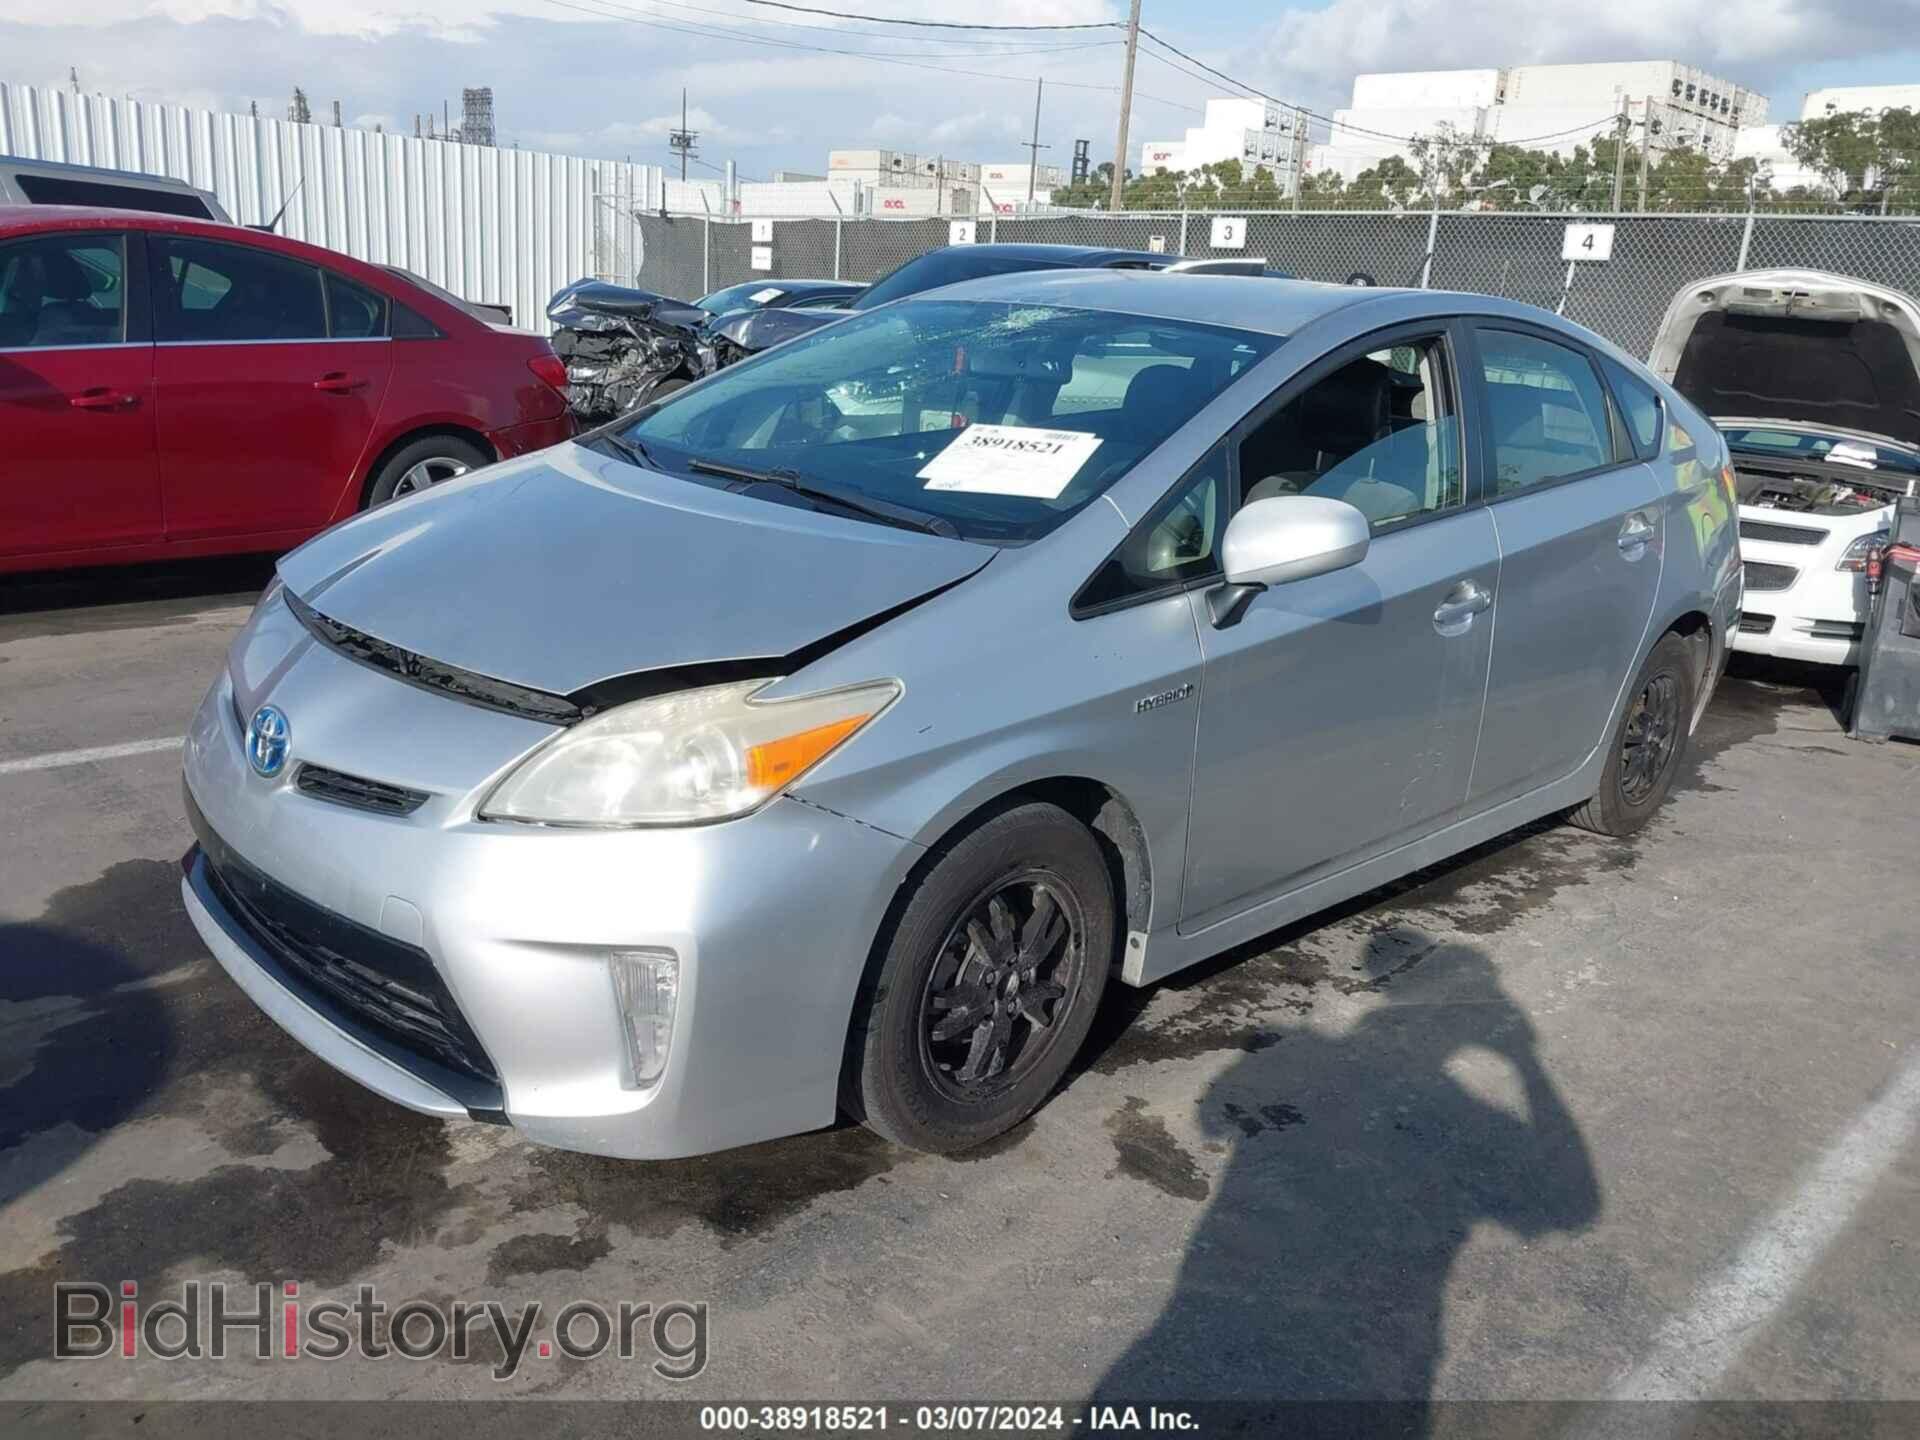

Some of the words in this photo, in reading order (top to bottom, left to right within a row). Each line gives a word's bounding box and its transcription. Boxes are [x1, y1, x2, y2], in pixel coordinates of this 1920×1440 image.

[959, 227, 967, 241] 2
[1223, 225, 1233, 240] 3
[1581, 233, 1595, 251] 4
[964, 435, 1064, 455] 38918521
[1134, 683, 1194, 714] HYBRID
